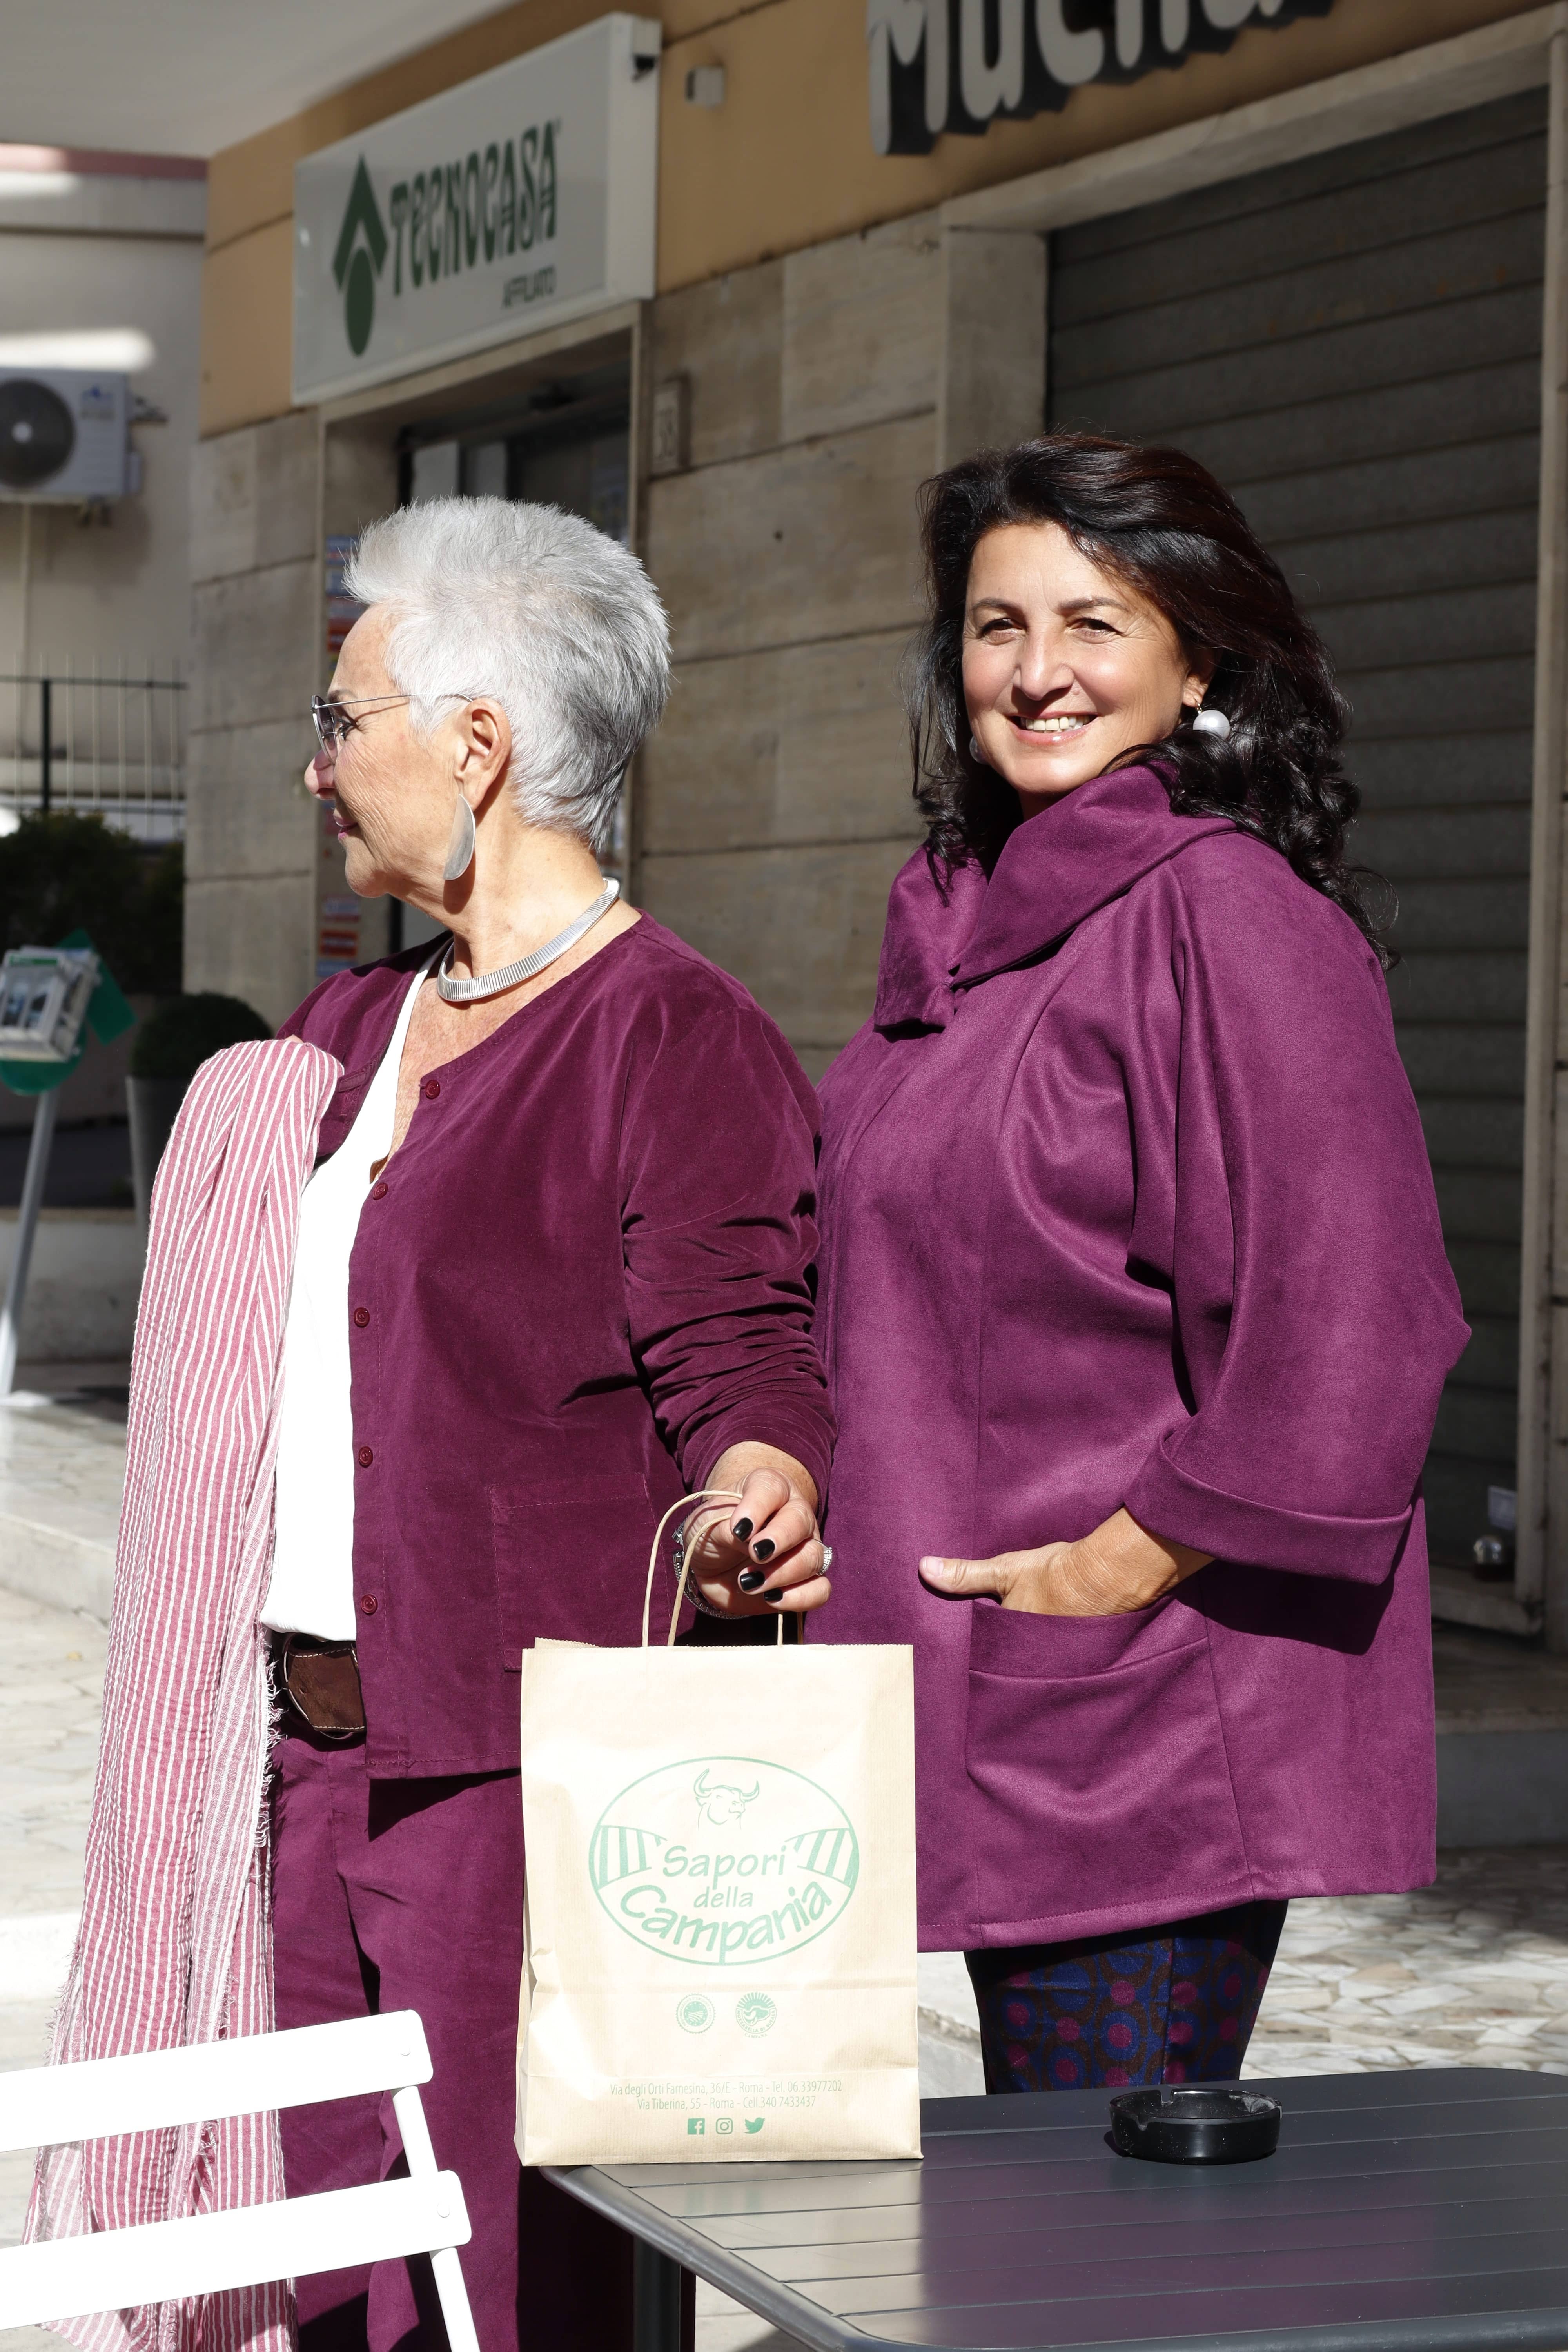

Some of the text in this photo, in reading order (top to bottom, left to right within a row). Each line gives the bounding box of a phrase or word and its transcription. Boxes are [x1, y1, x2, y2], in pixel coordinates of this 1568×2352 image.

[662, 1845, 786, 1890] Sapori
[693, 1886, 753, 1908] della
[620, 1881, 832, 1964] Campania
[610, 2083, 622, 2095] Via
[624, 2083, 646, 2098] degli
[648, 2083, 664, 2095] Orti
[666, 2082, 708, 2095] Farnesina,
[710, 2082, 731, 2094] 36/E
[739, 2082, 763, 2093] Roma
[771, 2081, 785, 2092] Tel.
[787, 2080, 842, 2092] 06.33977202
[637, 2098, 650, 2110] Via
[652, 2098, 688, 2111] Tiberina,
[690, 2098, 701, 2109] 55
[710, 2097, 734, 2109] Roma
[779, 2096, 816, 2108] 7433437
